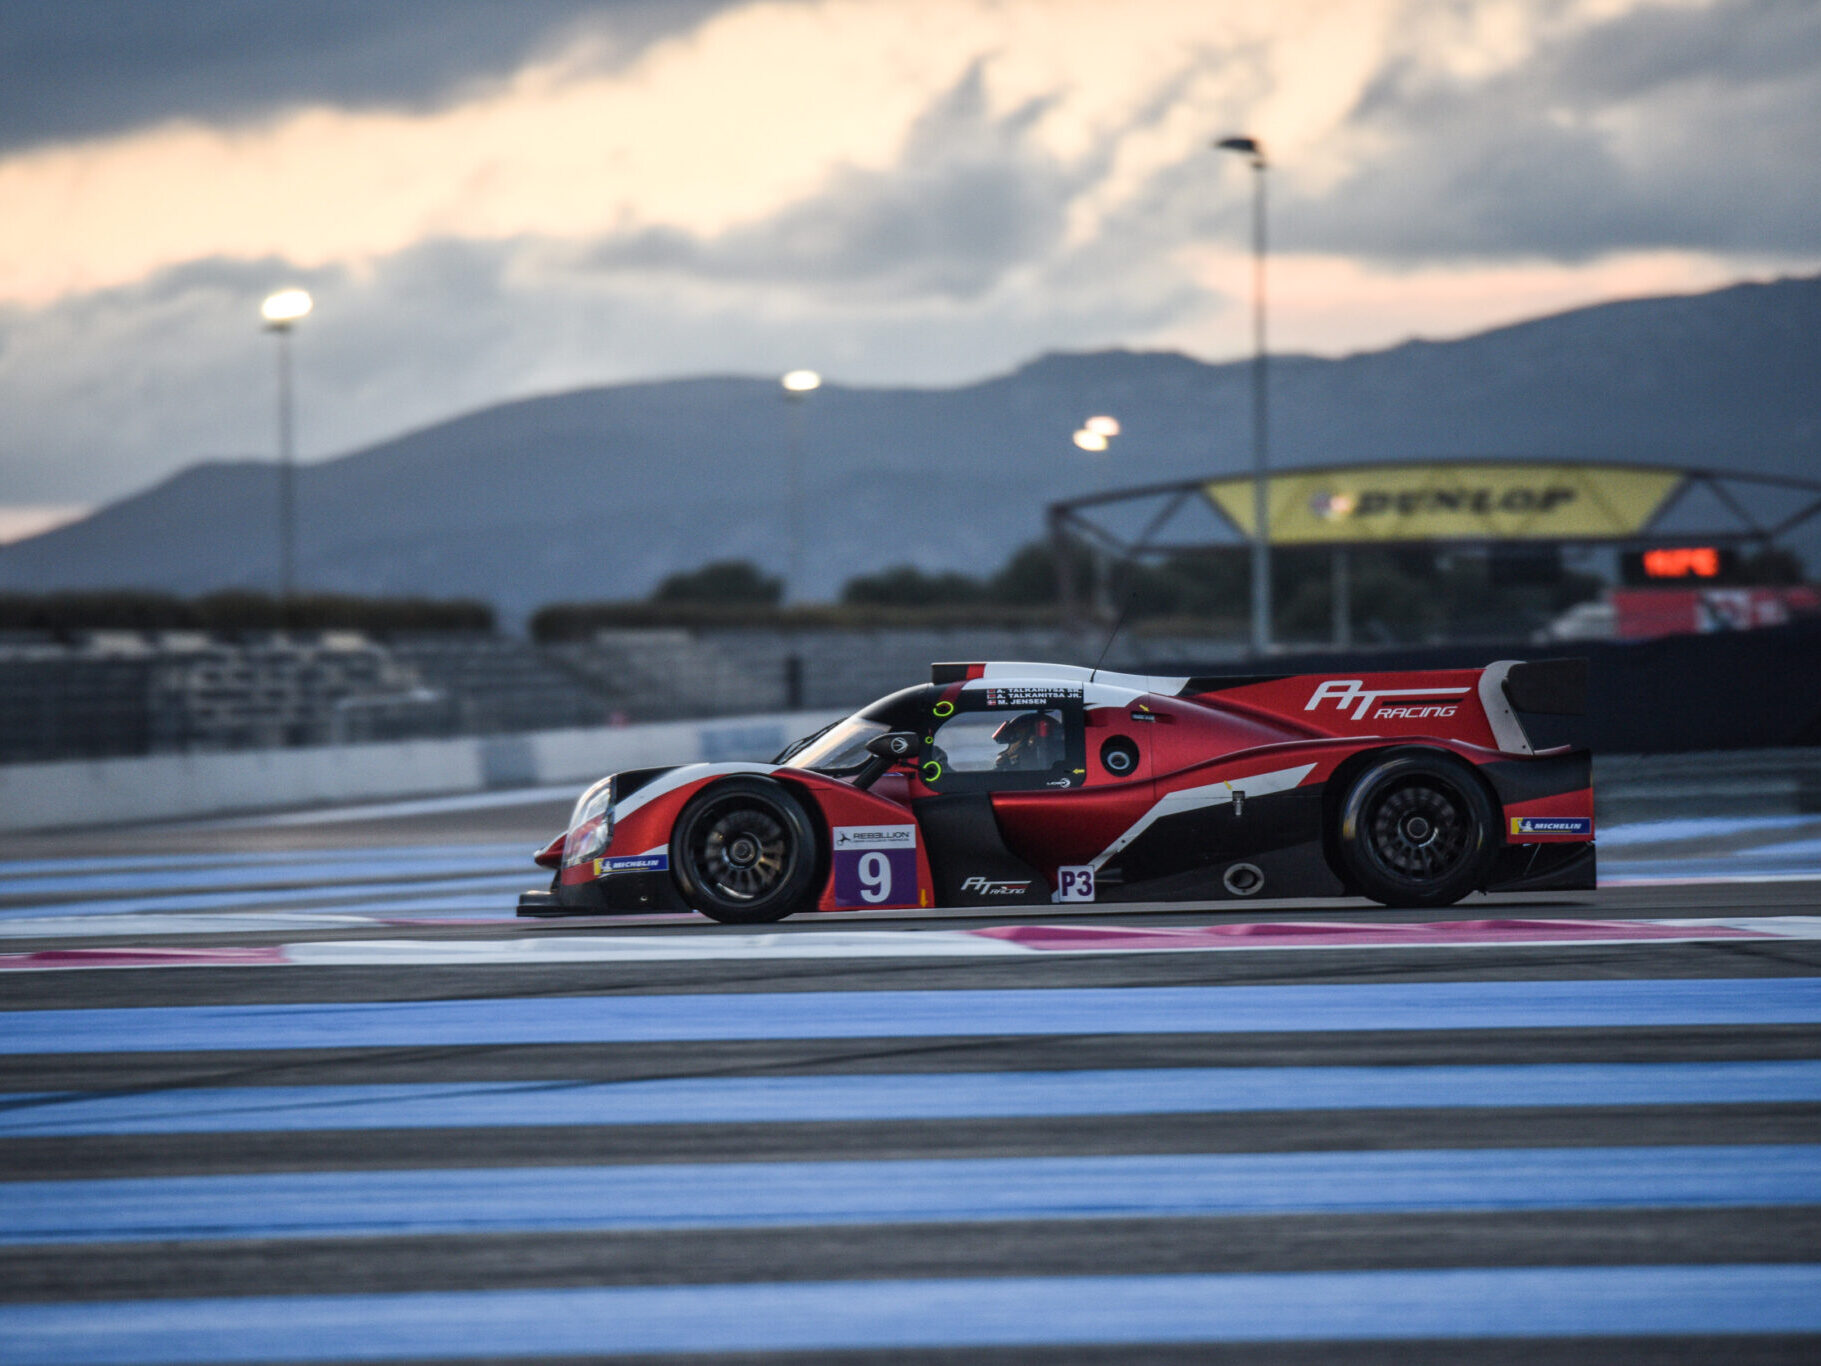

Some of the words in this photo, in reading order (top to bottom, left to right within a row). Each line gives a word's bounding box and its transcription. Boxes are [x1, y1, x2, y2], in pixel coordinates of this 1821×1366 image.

[1354, 487, 1577, 517] DUNLOP
[1374, 706, 1458, 719] RACING
[612, 860, 659, 869] MICHELIN
[858, 851, 892, 903] 9
[1061, 871, 1093, 896] P3
